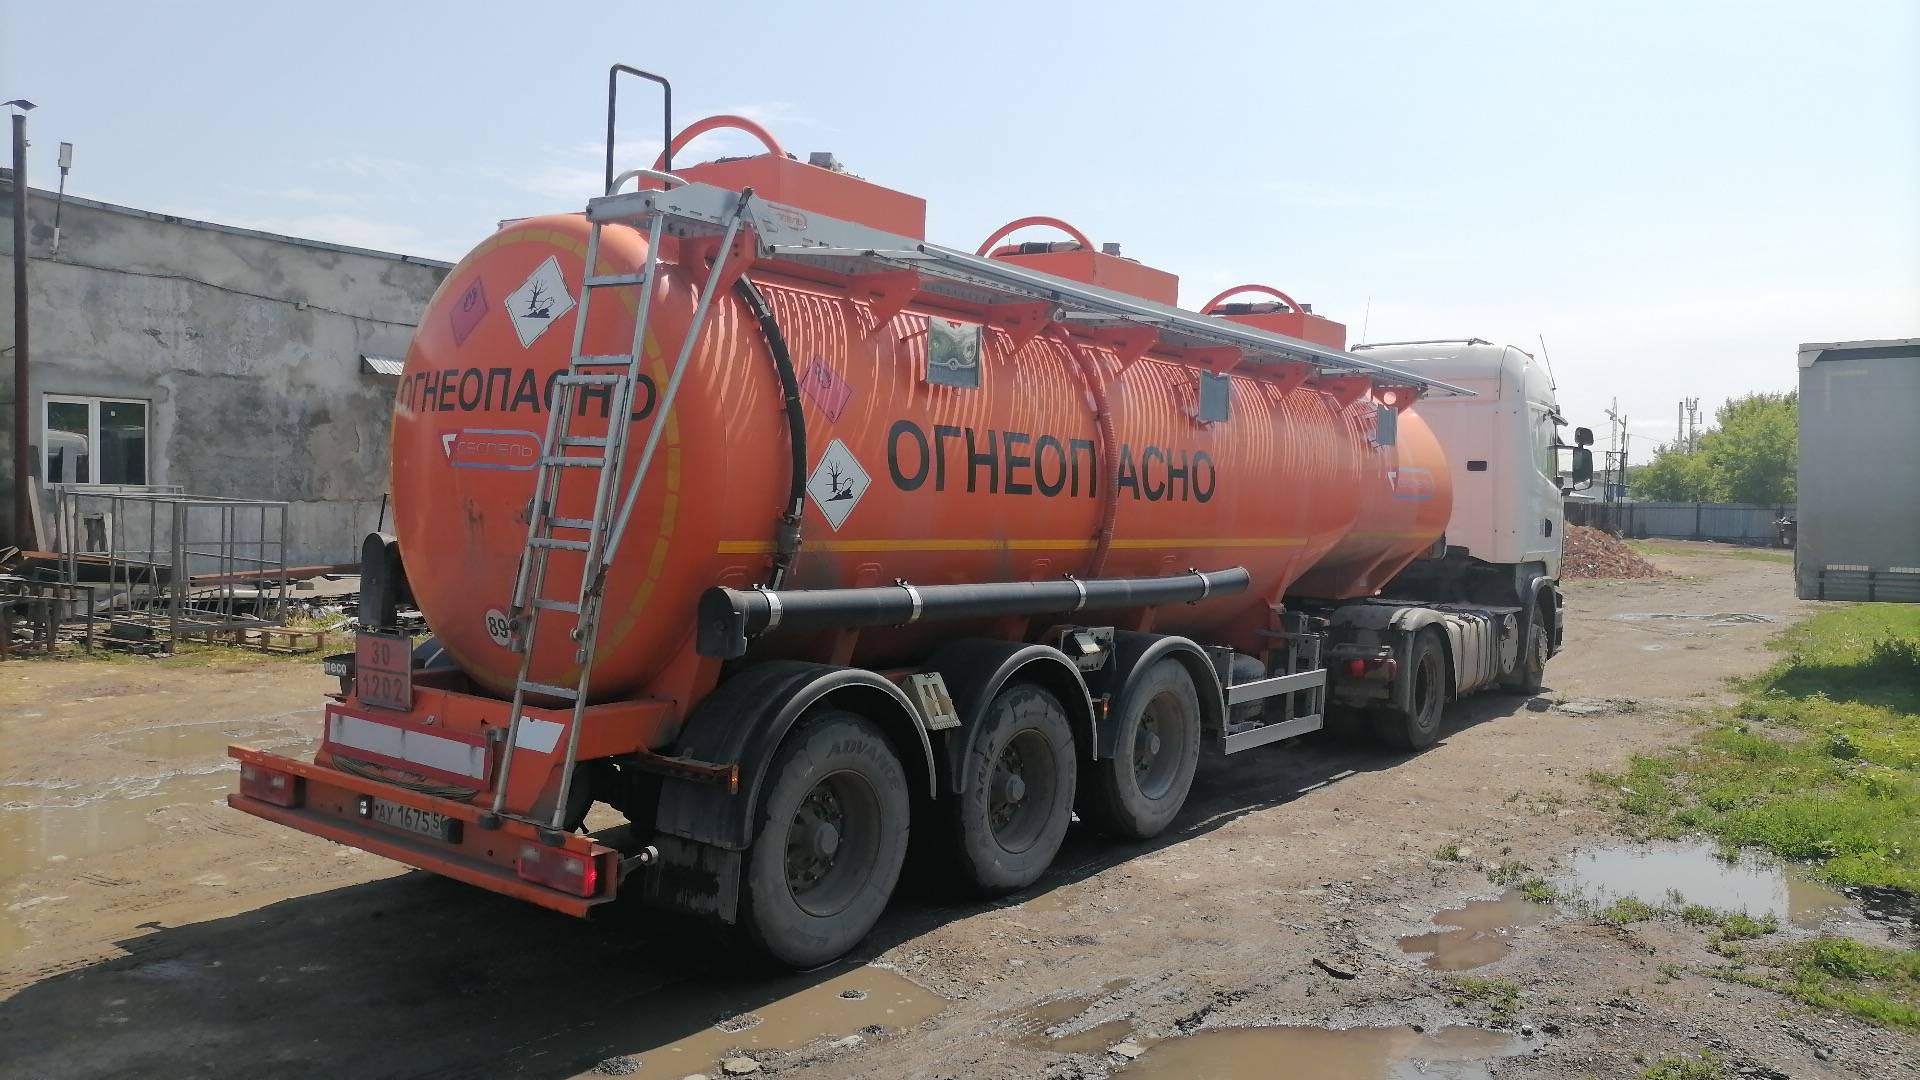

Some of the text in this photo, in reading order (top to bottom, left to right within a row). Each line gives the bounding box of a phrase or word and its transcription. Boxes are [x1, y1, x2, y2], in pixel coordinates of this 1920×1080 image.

[887, 419, 1216, 503] ОГНЕОПАСНО
[487, 616, 509, 638] 89
[371, 640, 391, 666] 30
[363, 673, 404, 703] 1202
[398, 805, 430, 832] 1675
